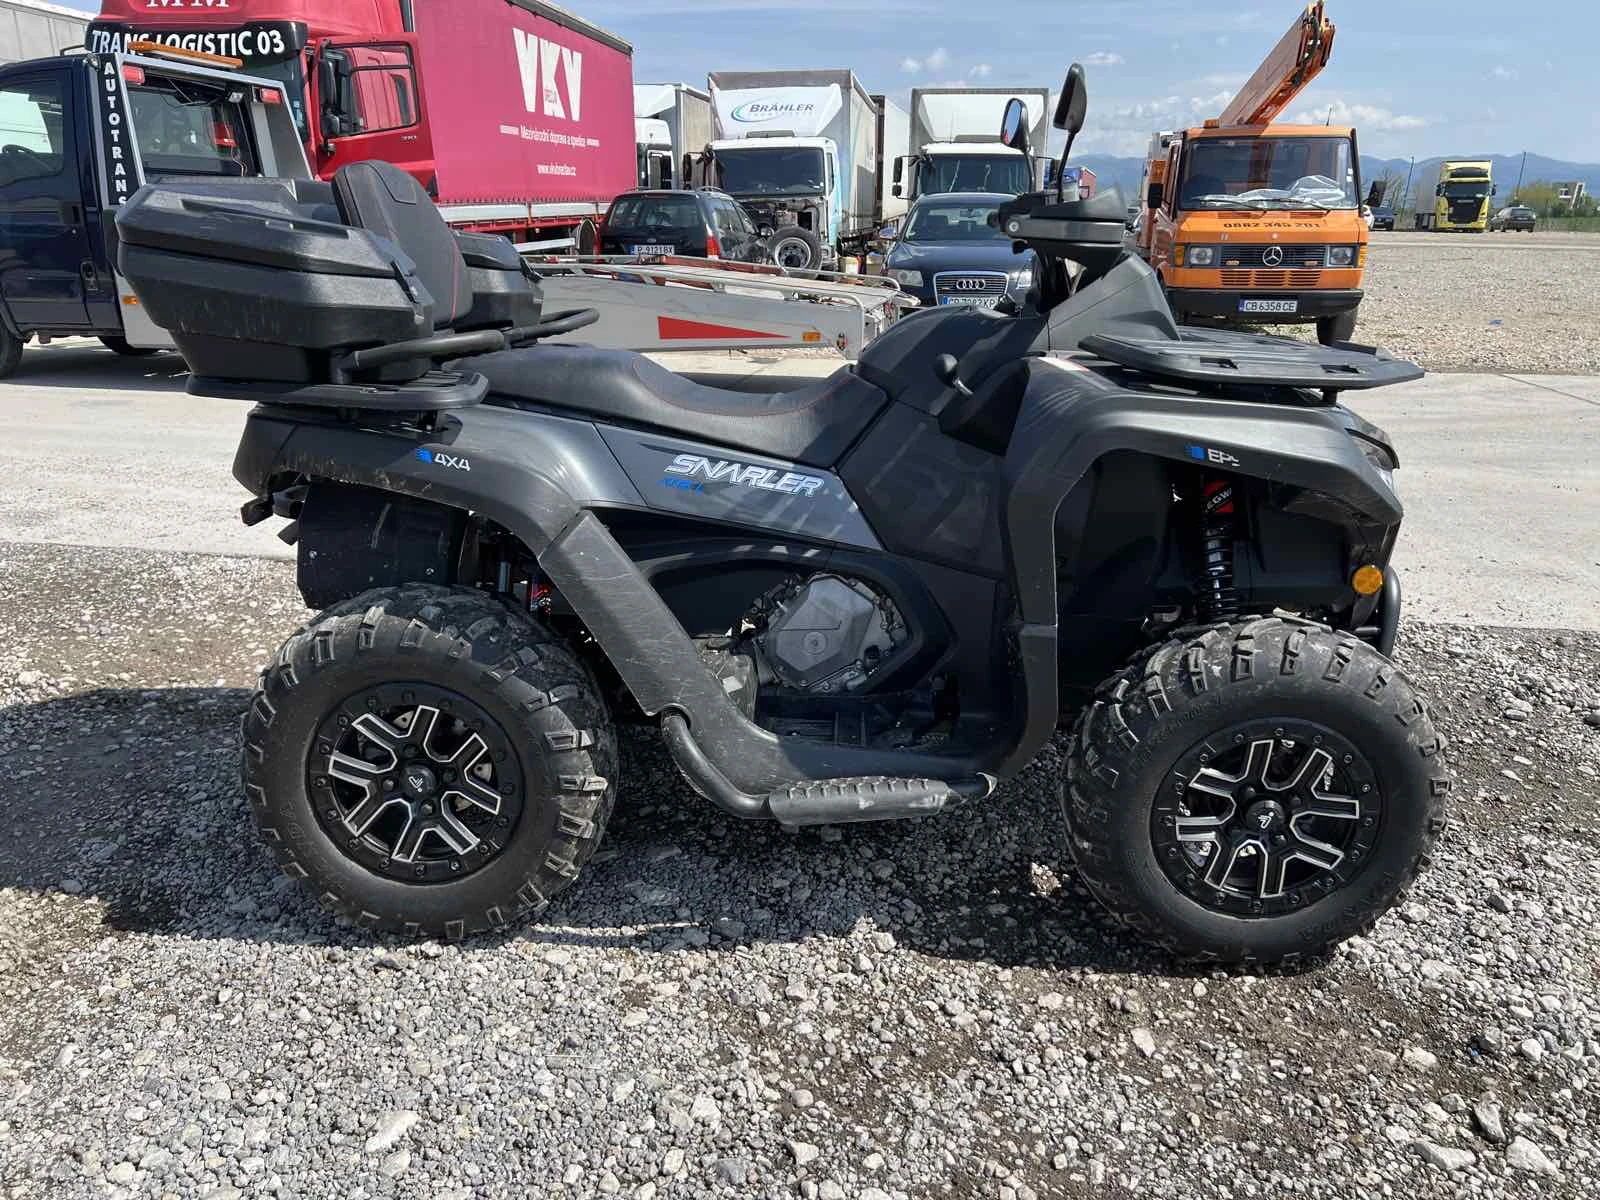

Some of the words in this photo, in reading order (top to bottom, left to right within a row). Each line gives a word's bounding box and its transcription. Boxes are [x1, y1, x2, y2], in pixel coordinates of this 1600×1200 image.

[257, 29, 285, 55] 03
[513, 27, 582, 122] VKV
[749, 102, 814, 113] BRÄHLER
[664, 454, 825, 497] SNARLER
